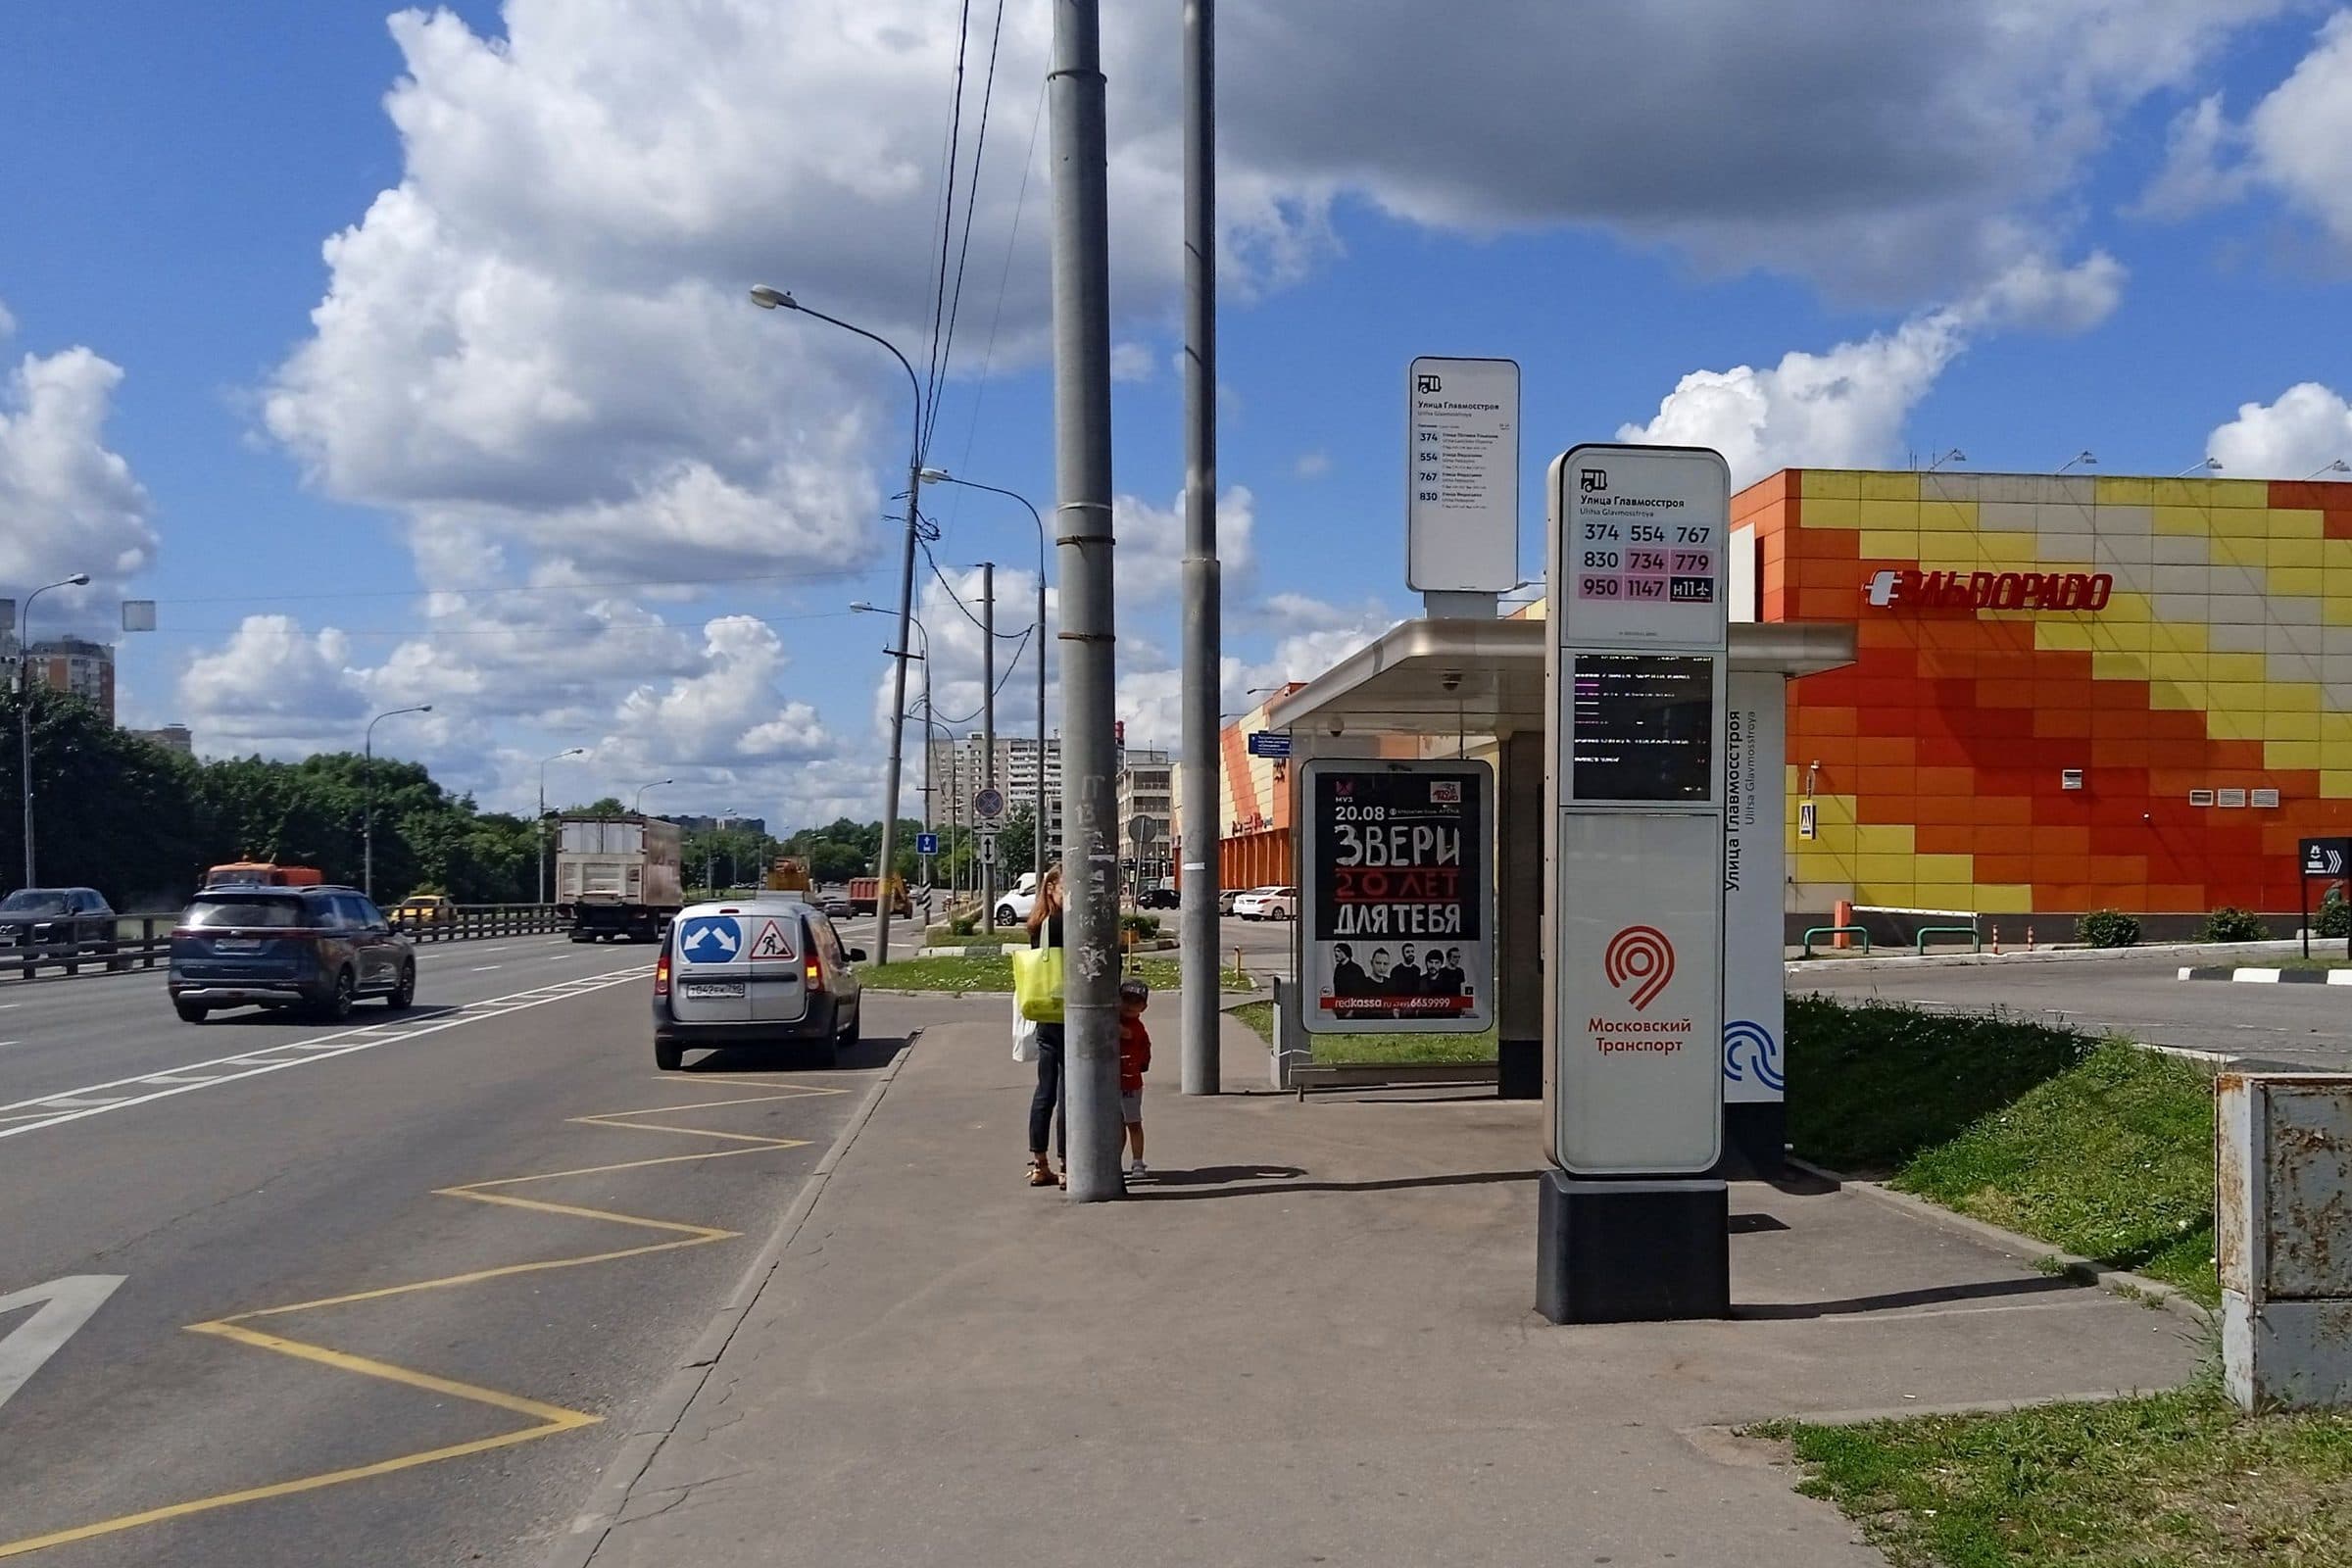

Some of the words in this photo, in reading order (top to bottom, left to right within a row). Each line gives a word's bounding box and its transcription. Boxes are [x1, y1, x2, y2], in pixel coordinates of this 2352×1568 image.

[1418, 400, 1443, 410] Улица
[1419, 432, 1438, 442] 374
[1420, 453, 1438, 462] 554
[1419, 472, 1438, 481] 767
[1419, 492, 1438, 502] 830
[1580, 494, 1612, 507] Улица
[1613, 496, 1685, 510] Главмосстроя
[1585, 523, 1620, 541] 374
[1630, 525, 1665, 542] 554
[1677, 526, 1710, 544] 767
[1584, 551, 1619, 568] 830
[1630, 553, 1664, 569] 734
[1675, 554, 1709, 571] 779
[1584, 578, 1619, 596] 950
[1628, 580, 1664, 597] 1147
[1744, 710, 1756, 792] Glavmosstroya
[1726, 710, 1742, 833] Главмосстроя
[1335, 806, 1385, 821] 20.08
[1744, 795, 1755, 825] Ulitsa
[1334, 824, 1460, 866] ЗВЕРИ
[1725, 838, 1741, 892] Улица
[1335, 872, 1389, 896] 20
[1398, 872, 1458, 896] ЛЕТ
[1334, 904, 1389, 934] ДЛЯ
[1392, 904, 1460, 934] ТЕБЯ
[1588, 1017, 1691, 1033] Московский
[1595, 1037, 1684, 1055] Транспорт
